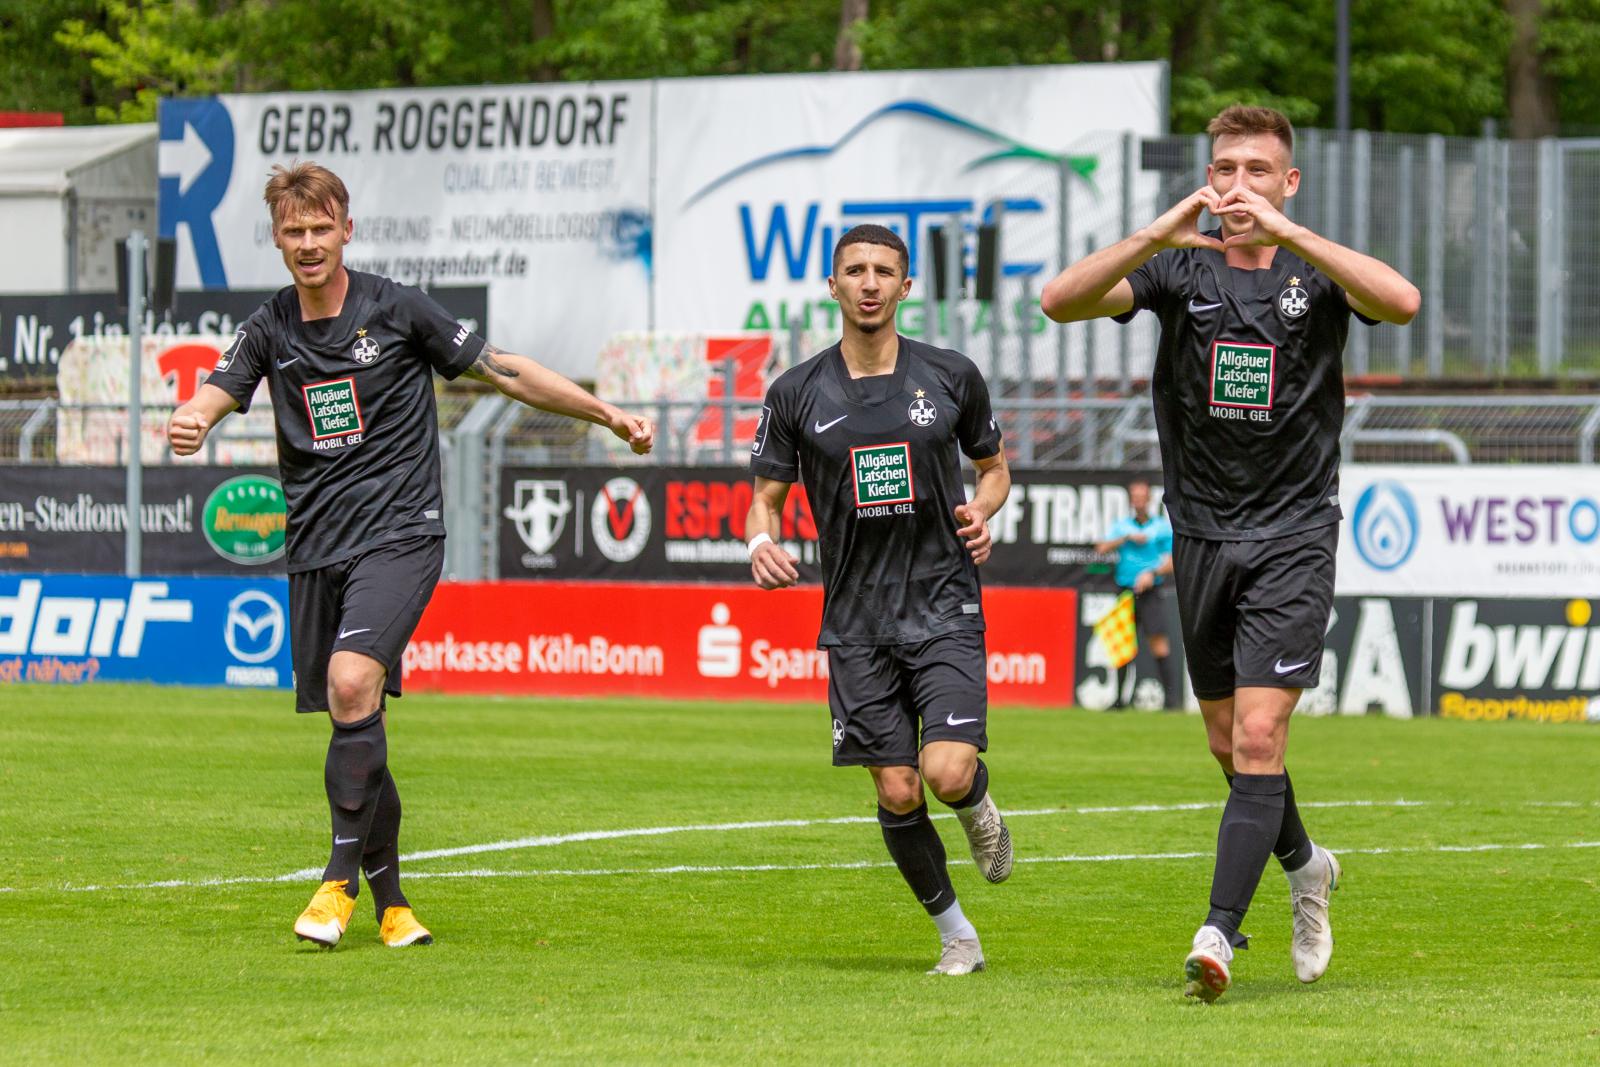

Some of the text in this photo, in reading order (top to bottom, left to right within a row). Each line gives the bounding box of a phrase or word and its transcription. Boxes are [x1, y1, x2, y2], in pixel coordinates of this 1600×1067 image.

[258, 95, 628, 153] GEBR. ROGGENDORF
[14, 314, 59, 364] Nr.
[1219, 351, 1268, 369] Allgäuer
[1217, 366, 1267, 383] Latschen
[310, 388, 350, 405] Allgäuer
[312, 401, 354, 418] Latschen
[1209, 406, 1272, 422] MOBIL GEL
[313, 438, 345, 450] MOBIL
[858, 453, 904, 470] Allgäuer
[859, 467, 906, 483] Latschen
[857, 504, 915, 519] MOBIL GEL
[0, 579, 193, 657] dorf
[402, 633, 663, 680] parkasse KölnBonn
[1439, 691, 1589, 723] Sportwett
